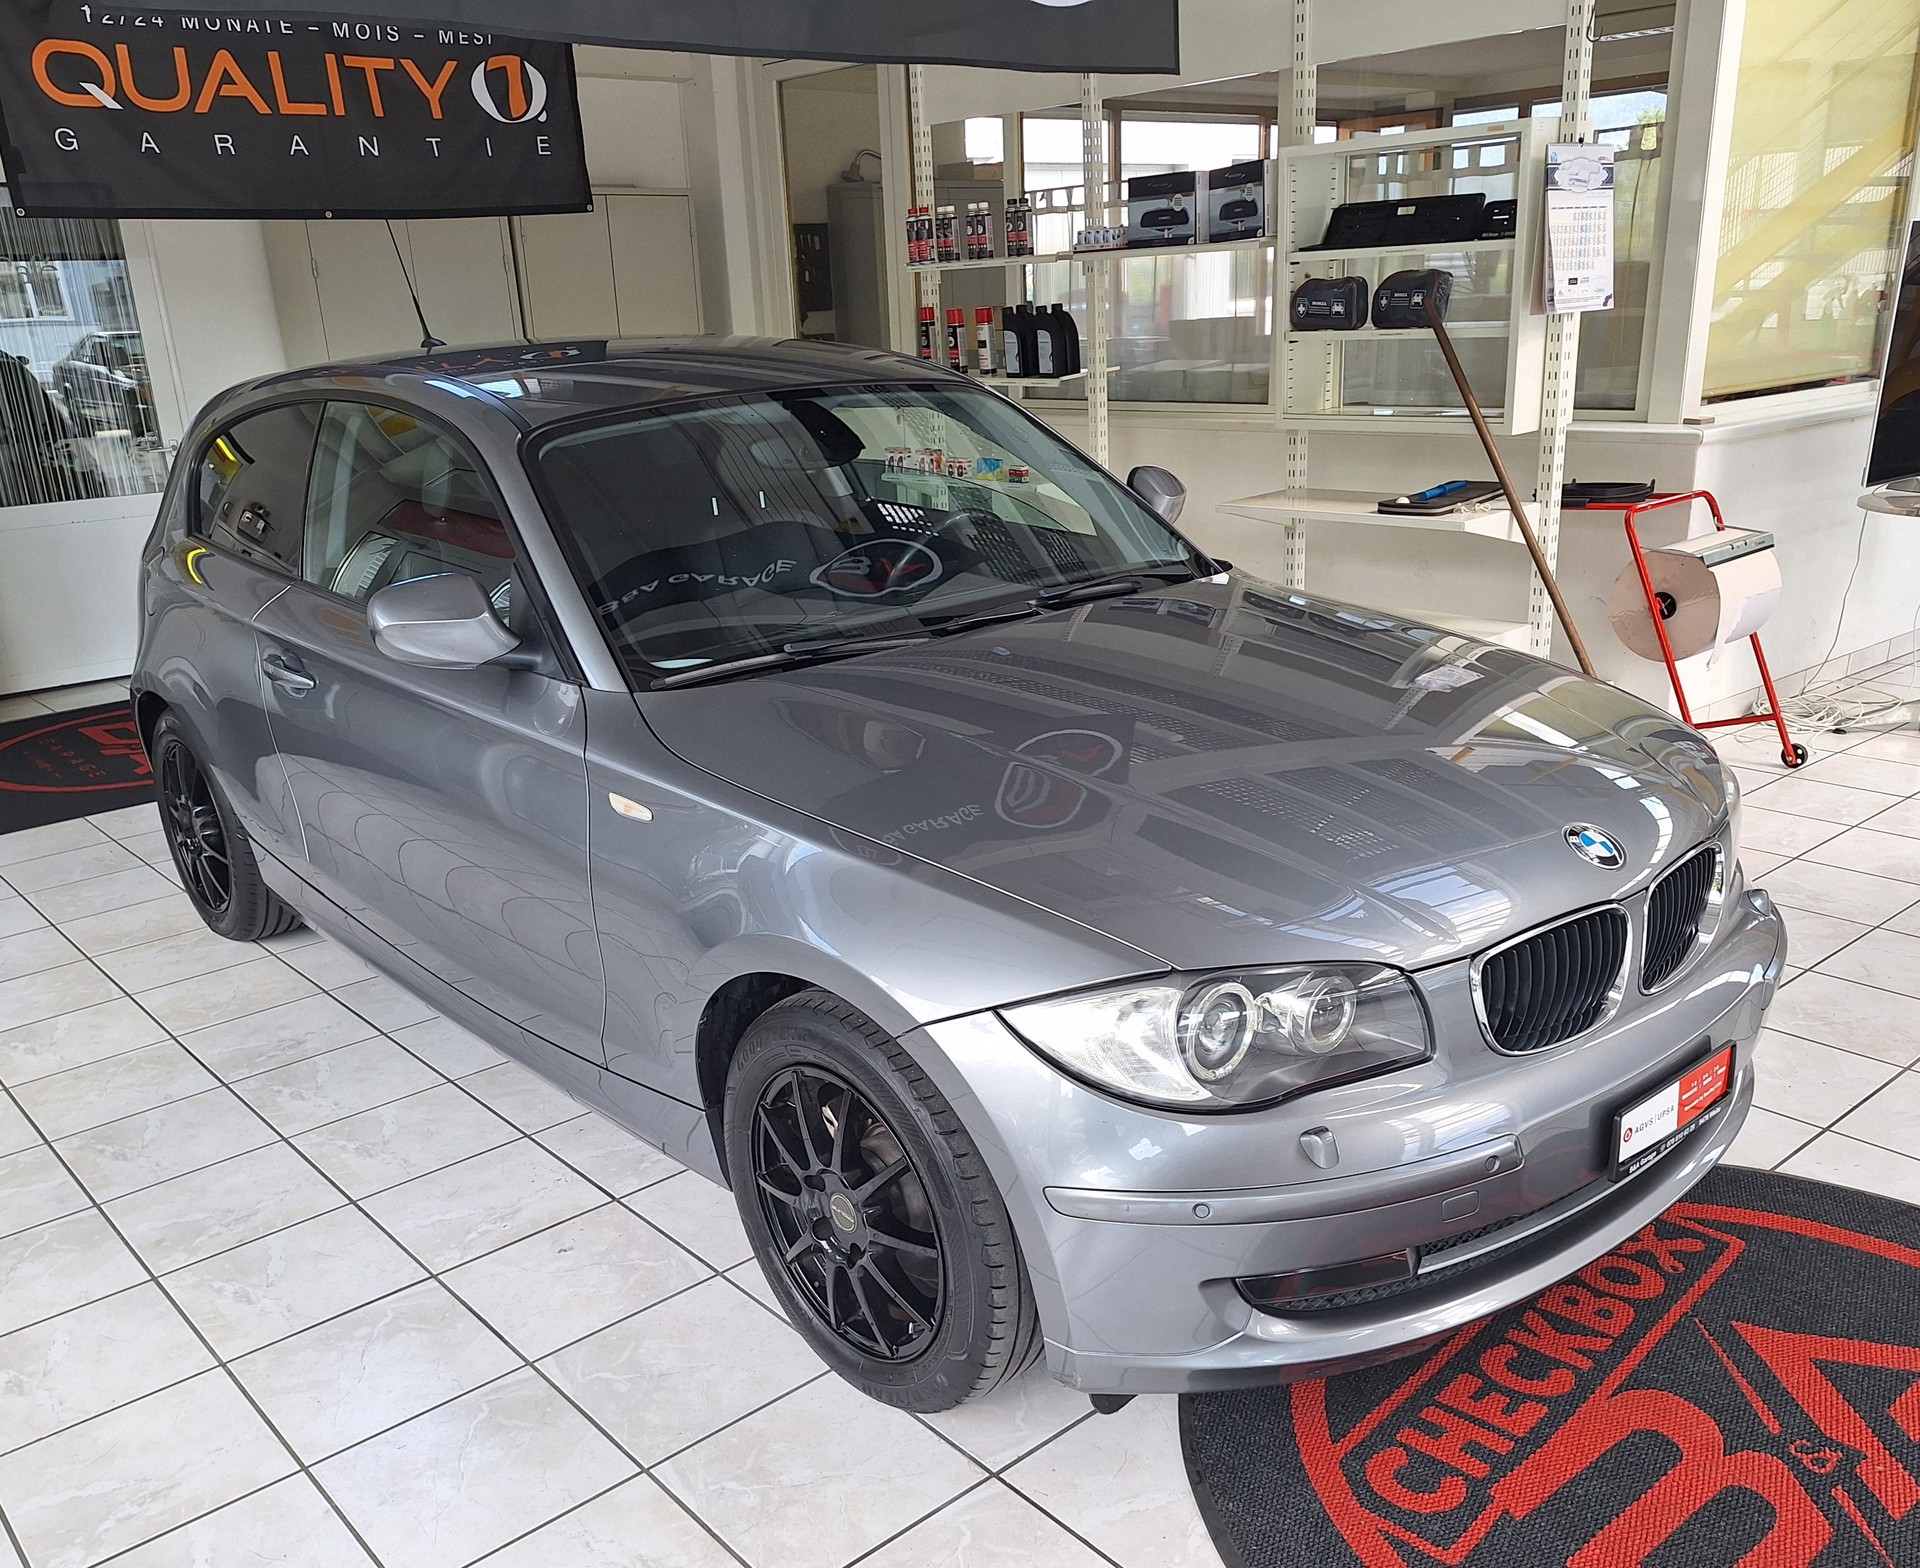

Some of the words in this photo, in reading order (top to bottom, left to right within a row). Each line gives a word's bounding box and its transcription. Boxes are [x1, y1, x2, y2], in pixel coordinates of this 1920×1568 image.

[332, 22, 400, 41] MOIS
[31, 38, 458, 120] QUALITY
[54, 127, 551, 157] GARANTIE
[1365, 1224, 1706, 1514] CHECKBOX
